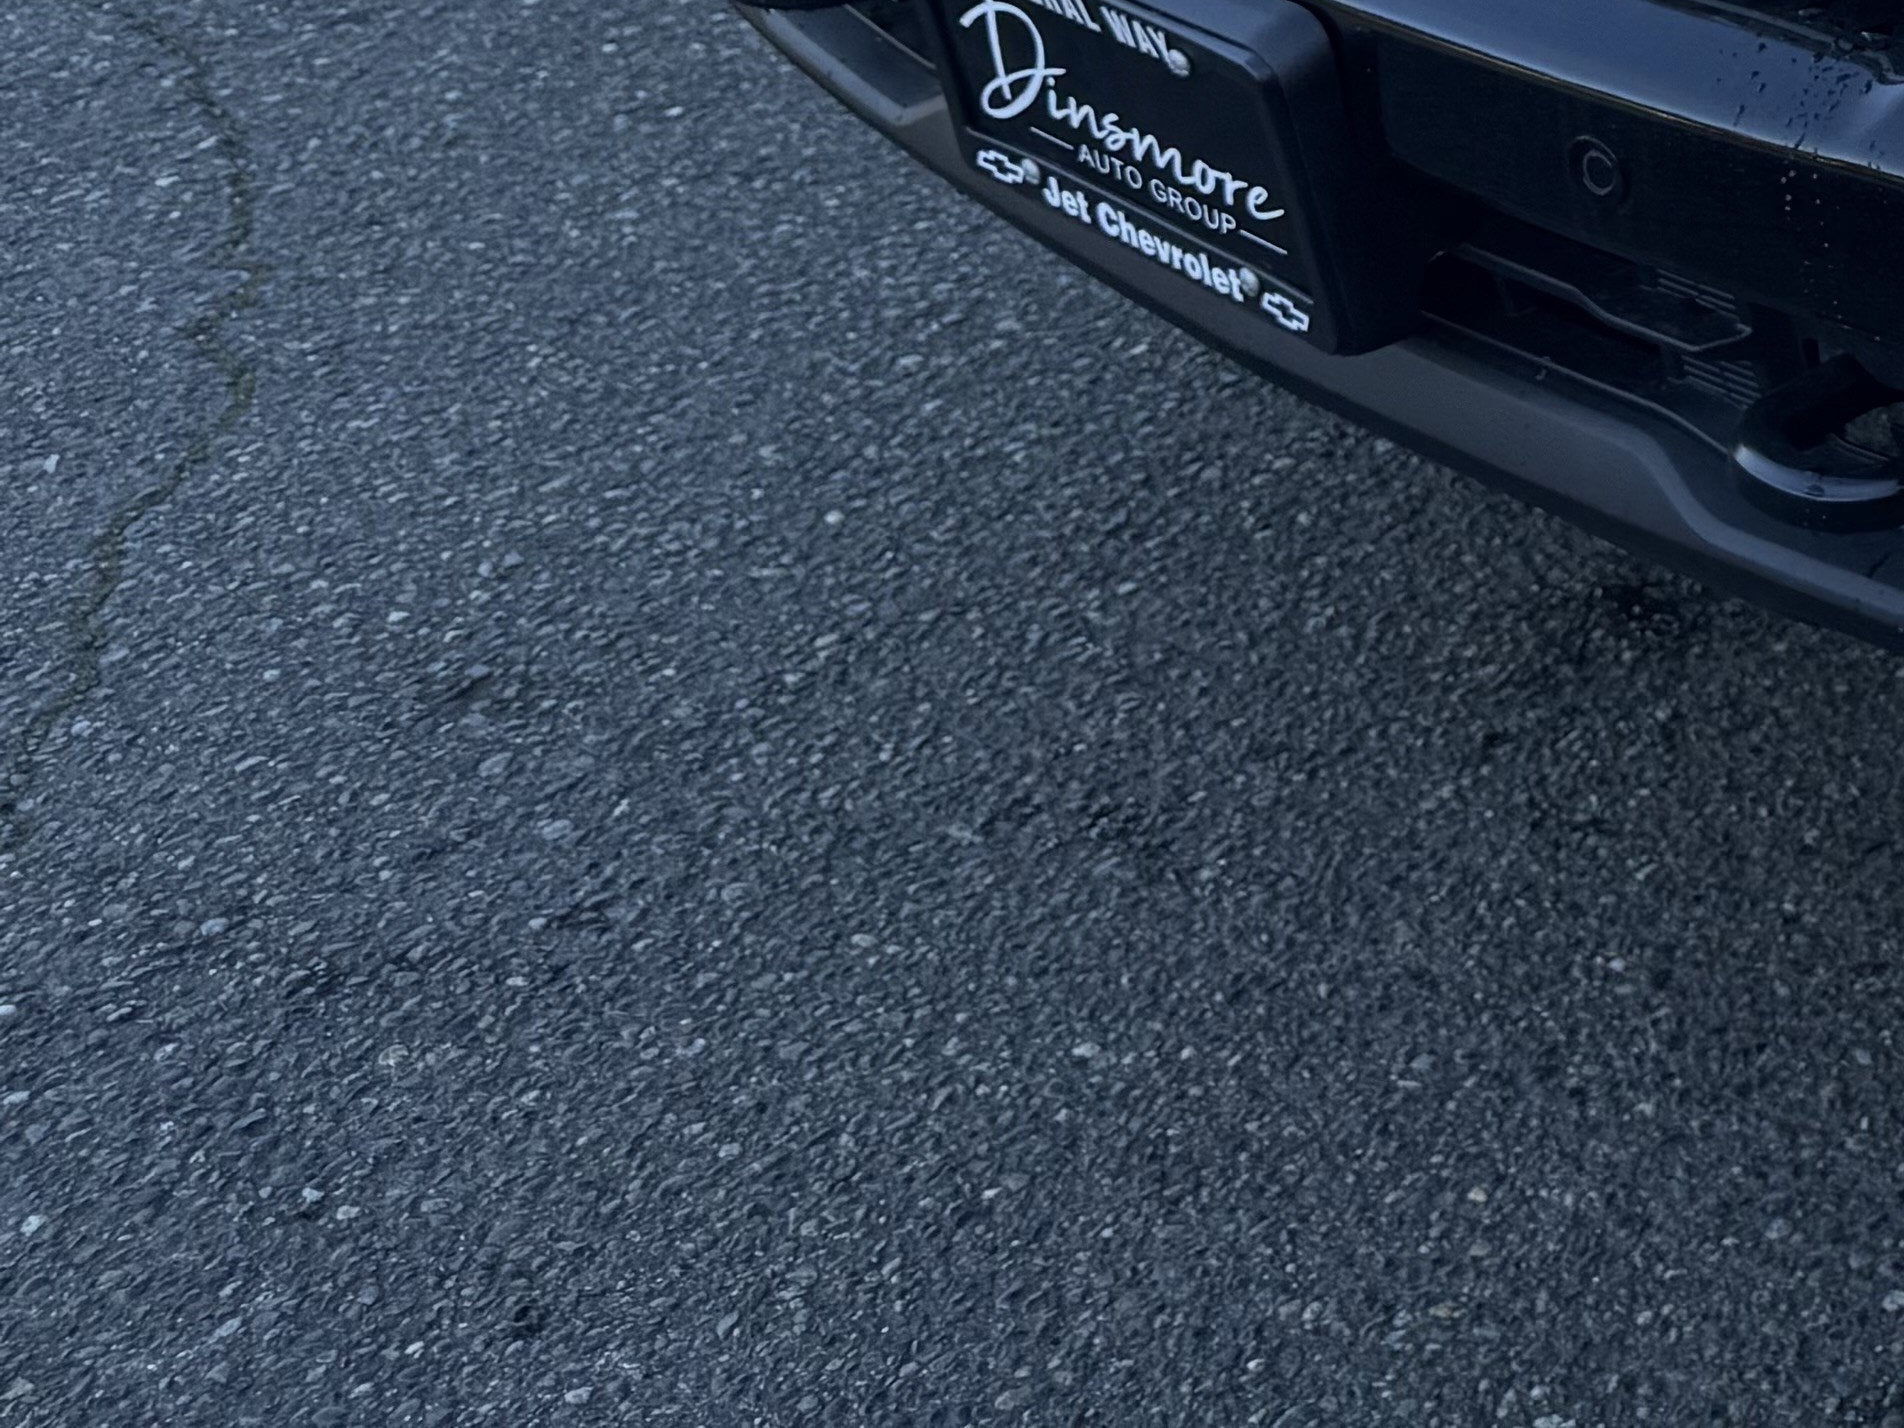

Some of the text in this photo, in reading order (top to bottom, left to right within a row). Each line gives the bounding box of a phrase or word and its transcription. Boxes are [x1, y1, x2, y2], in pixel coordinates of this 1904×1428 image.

[1100, 5, 1174, 71] WAY
[1077, 144, 1237, 235] AUTO GROUP
[1042, 176, 1245, 303] Jet Chevrolet
